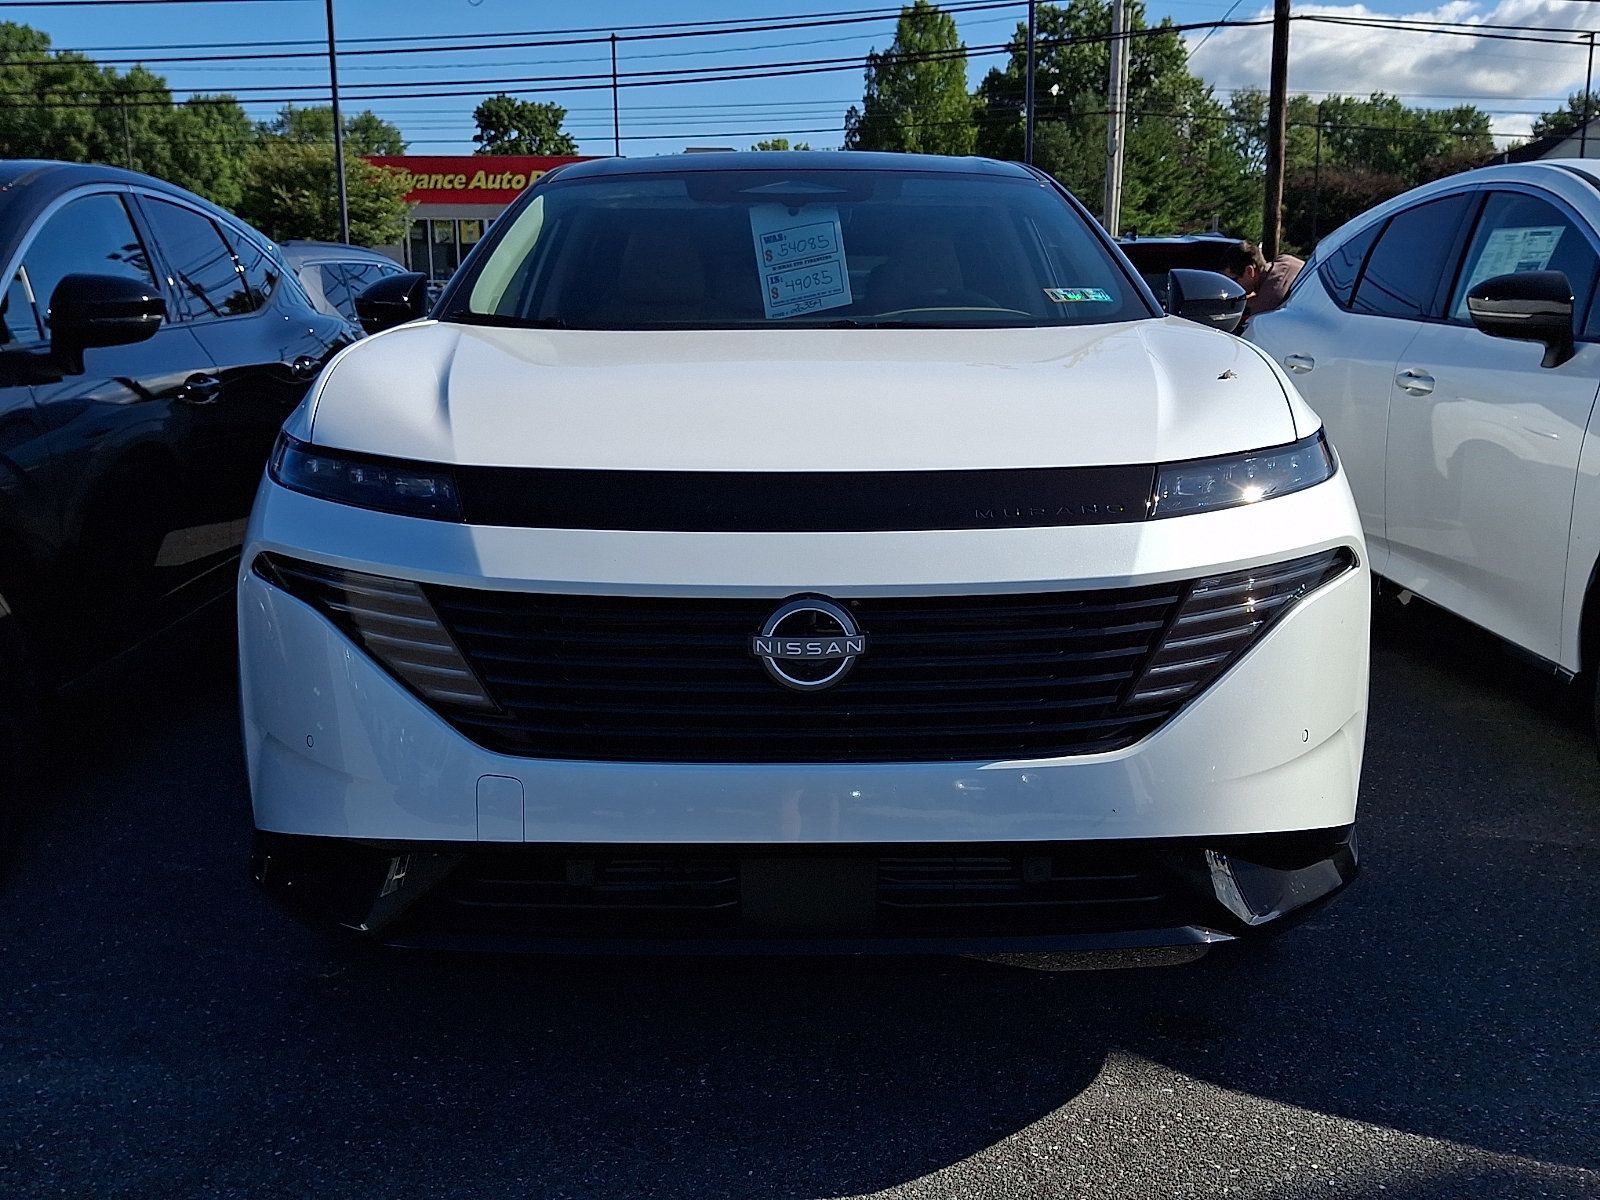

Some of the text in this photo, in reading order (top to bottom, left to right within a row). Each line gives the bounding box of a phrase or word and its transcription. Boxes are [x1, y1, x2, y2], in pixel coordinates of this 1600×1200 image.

[468, 170, 526, 190] Auto
[778, 235, 830, 257] 54085
[785, 270, 833, 292] 49085
[975, 503, 1125, 519] MURANO
[756, 639, 862, 655] NISSAN
